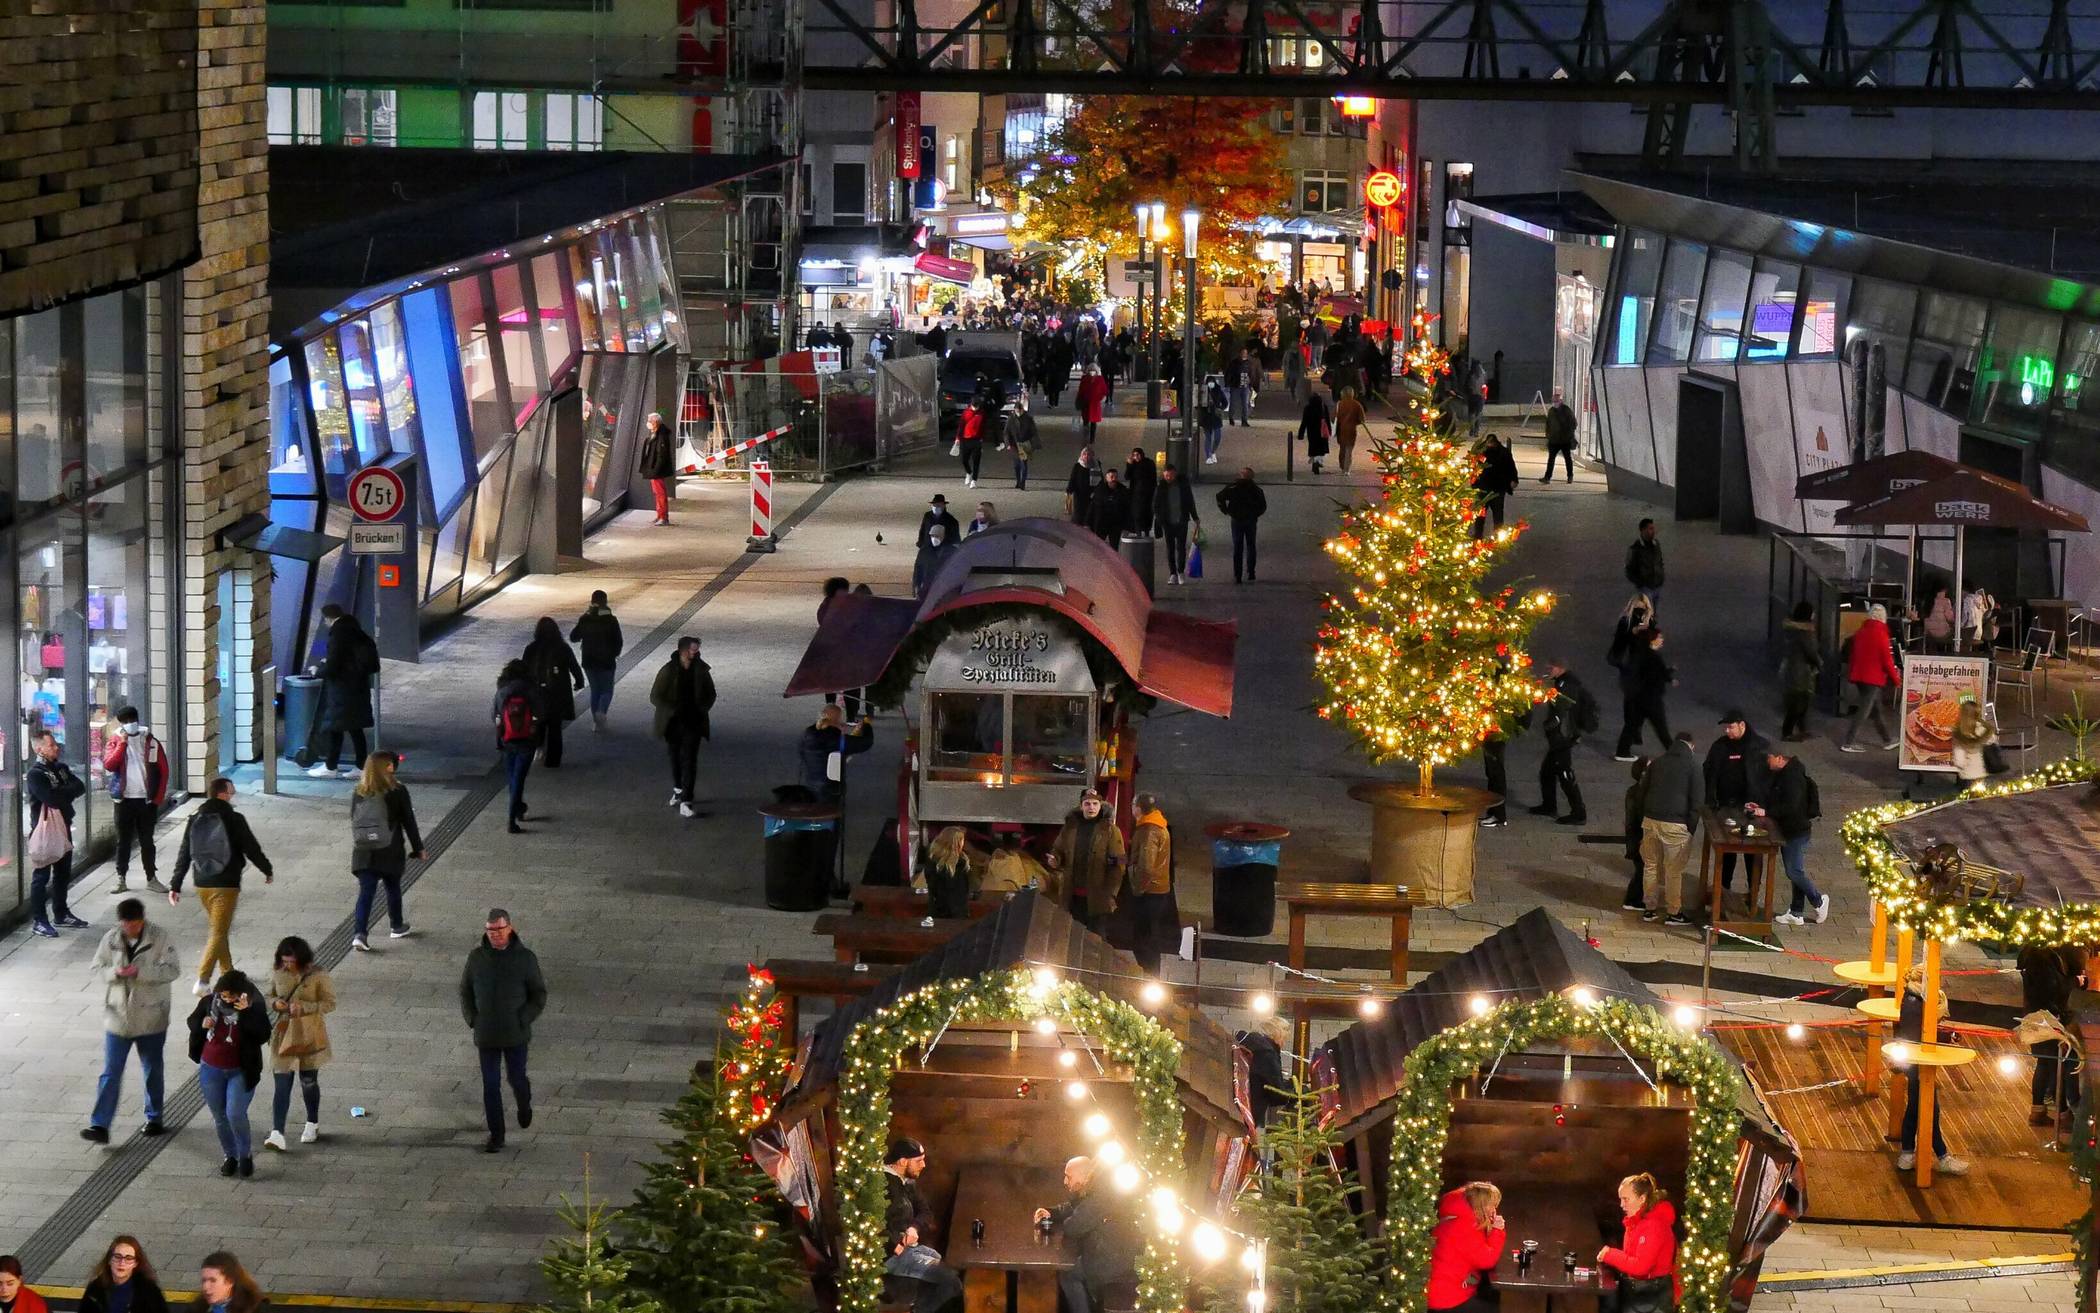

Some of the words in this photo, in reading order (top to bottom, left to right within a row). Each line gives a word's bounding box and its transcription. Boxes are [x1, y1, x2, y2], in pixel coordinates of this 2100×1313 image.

[1806, 453, 1820, 469] CITY
[1937, 502, 1989, 513] back
[1936, 511, 1990, 521] WERK
[985, 652, 1033, 667] Grill-
[962, 666, 1056, 683] Spezialitäten
[1912, 664, 1980, 678] #kebabgefahren
